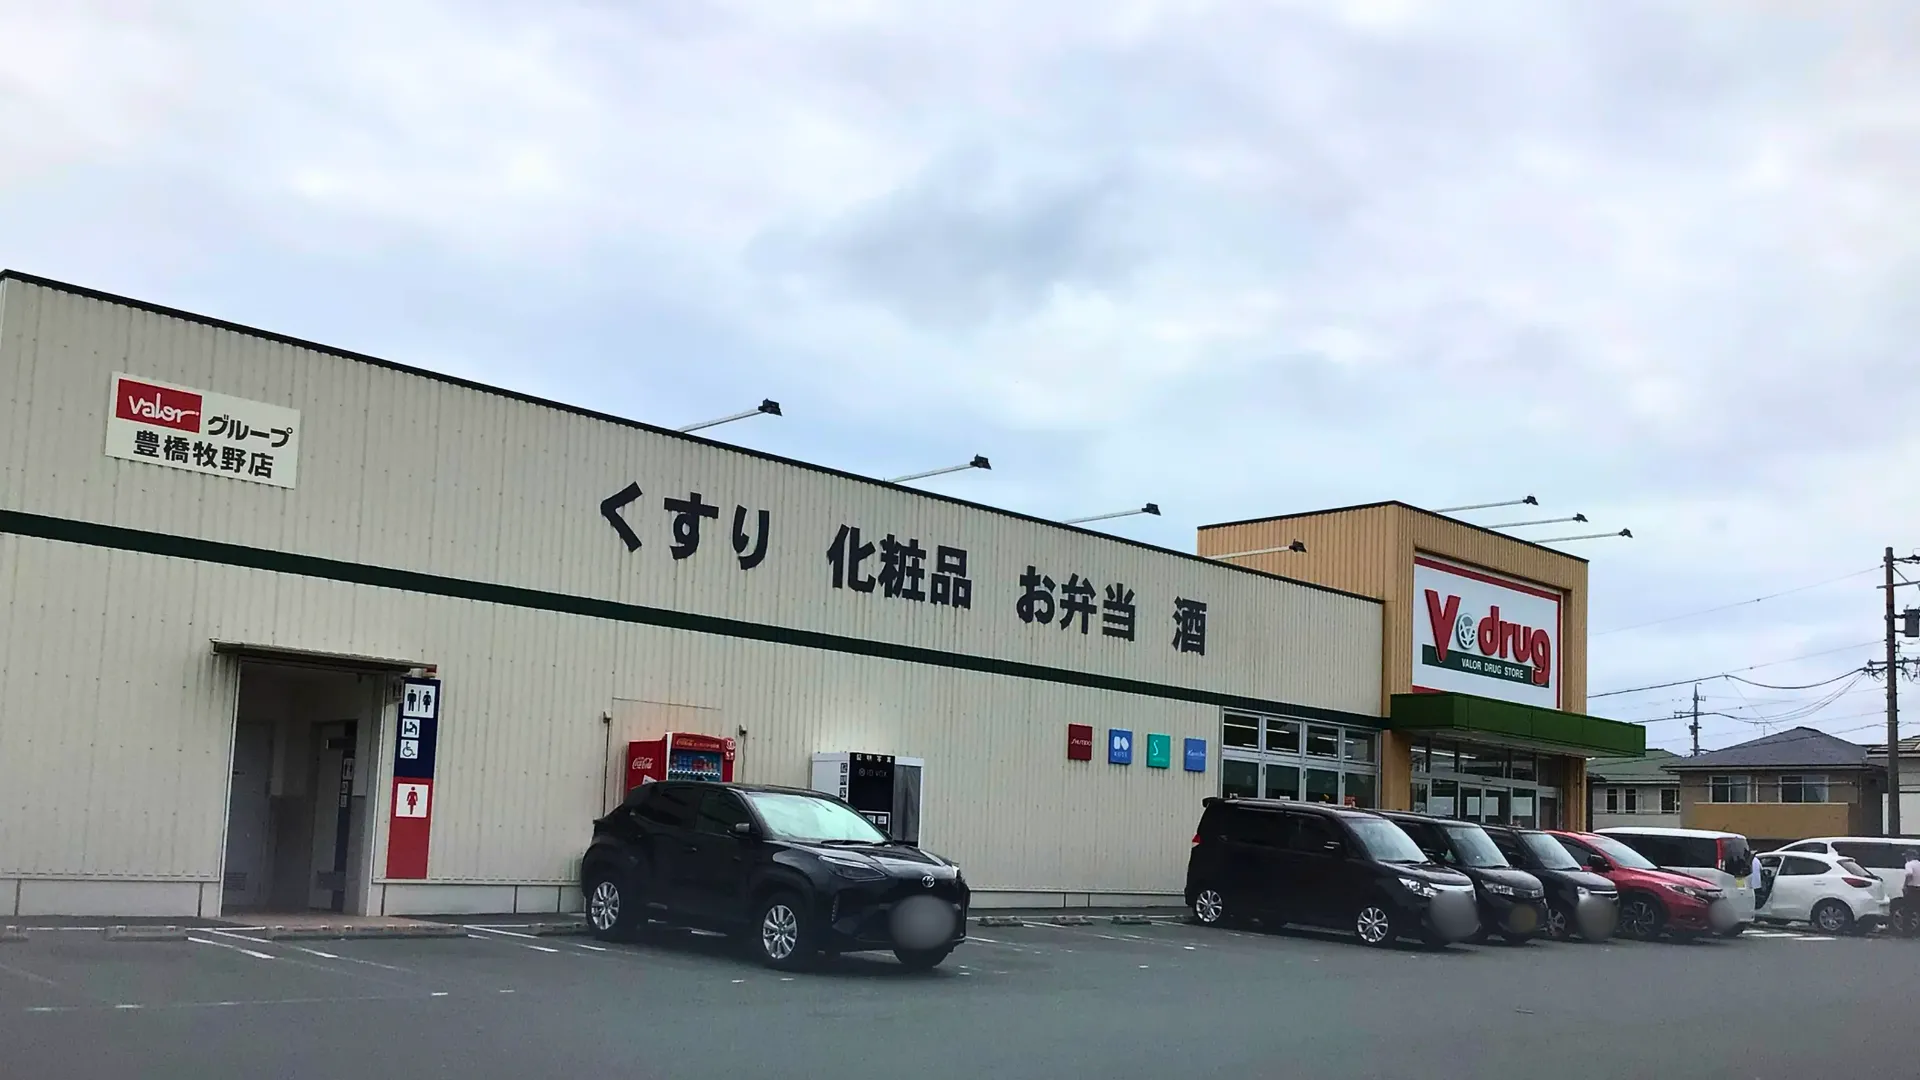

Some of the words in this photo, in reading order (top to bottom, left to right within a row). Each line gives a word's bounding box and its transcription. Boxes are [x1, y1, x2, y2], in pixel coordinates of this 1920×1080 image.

[207, 413, 294, 448] グループ
[133, 430, 274, 479] 豊橋牧野店
[600, 481, 770, 571] くすり
[827, 524, 973, 610] 化粧品
[1016, 565, 1136, 642] お弁当
[1172, 595, 1207, 656] 酒
[1461, 658, 1482, 671] VALOR
[1484, 662, 1502, 675] DRUG
[1504, 666, 1524, 679] STORE
